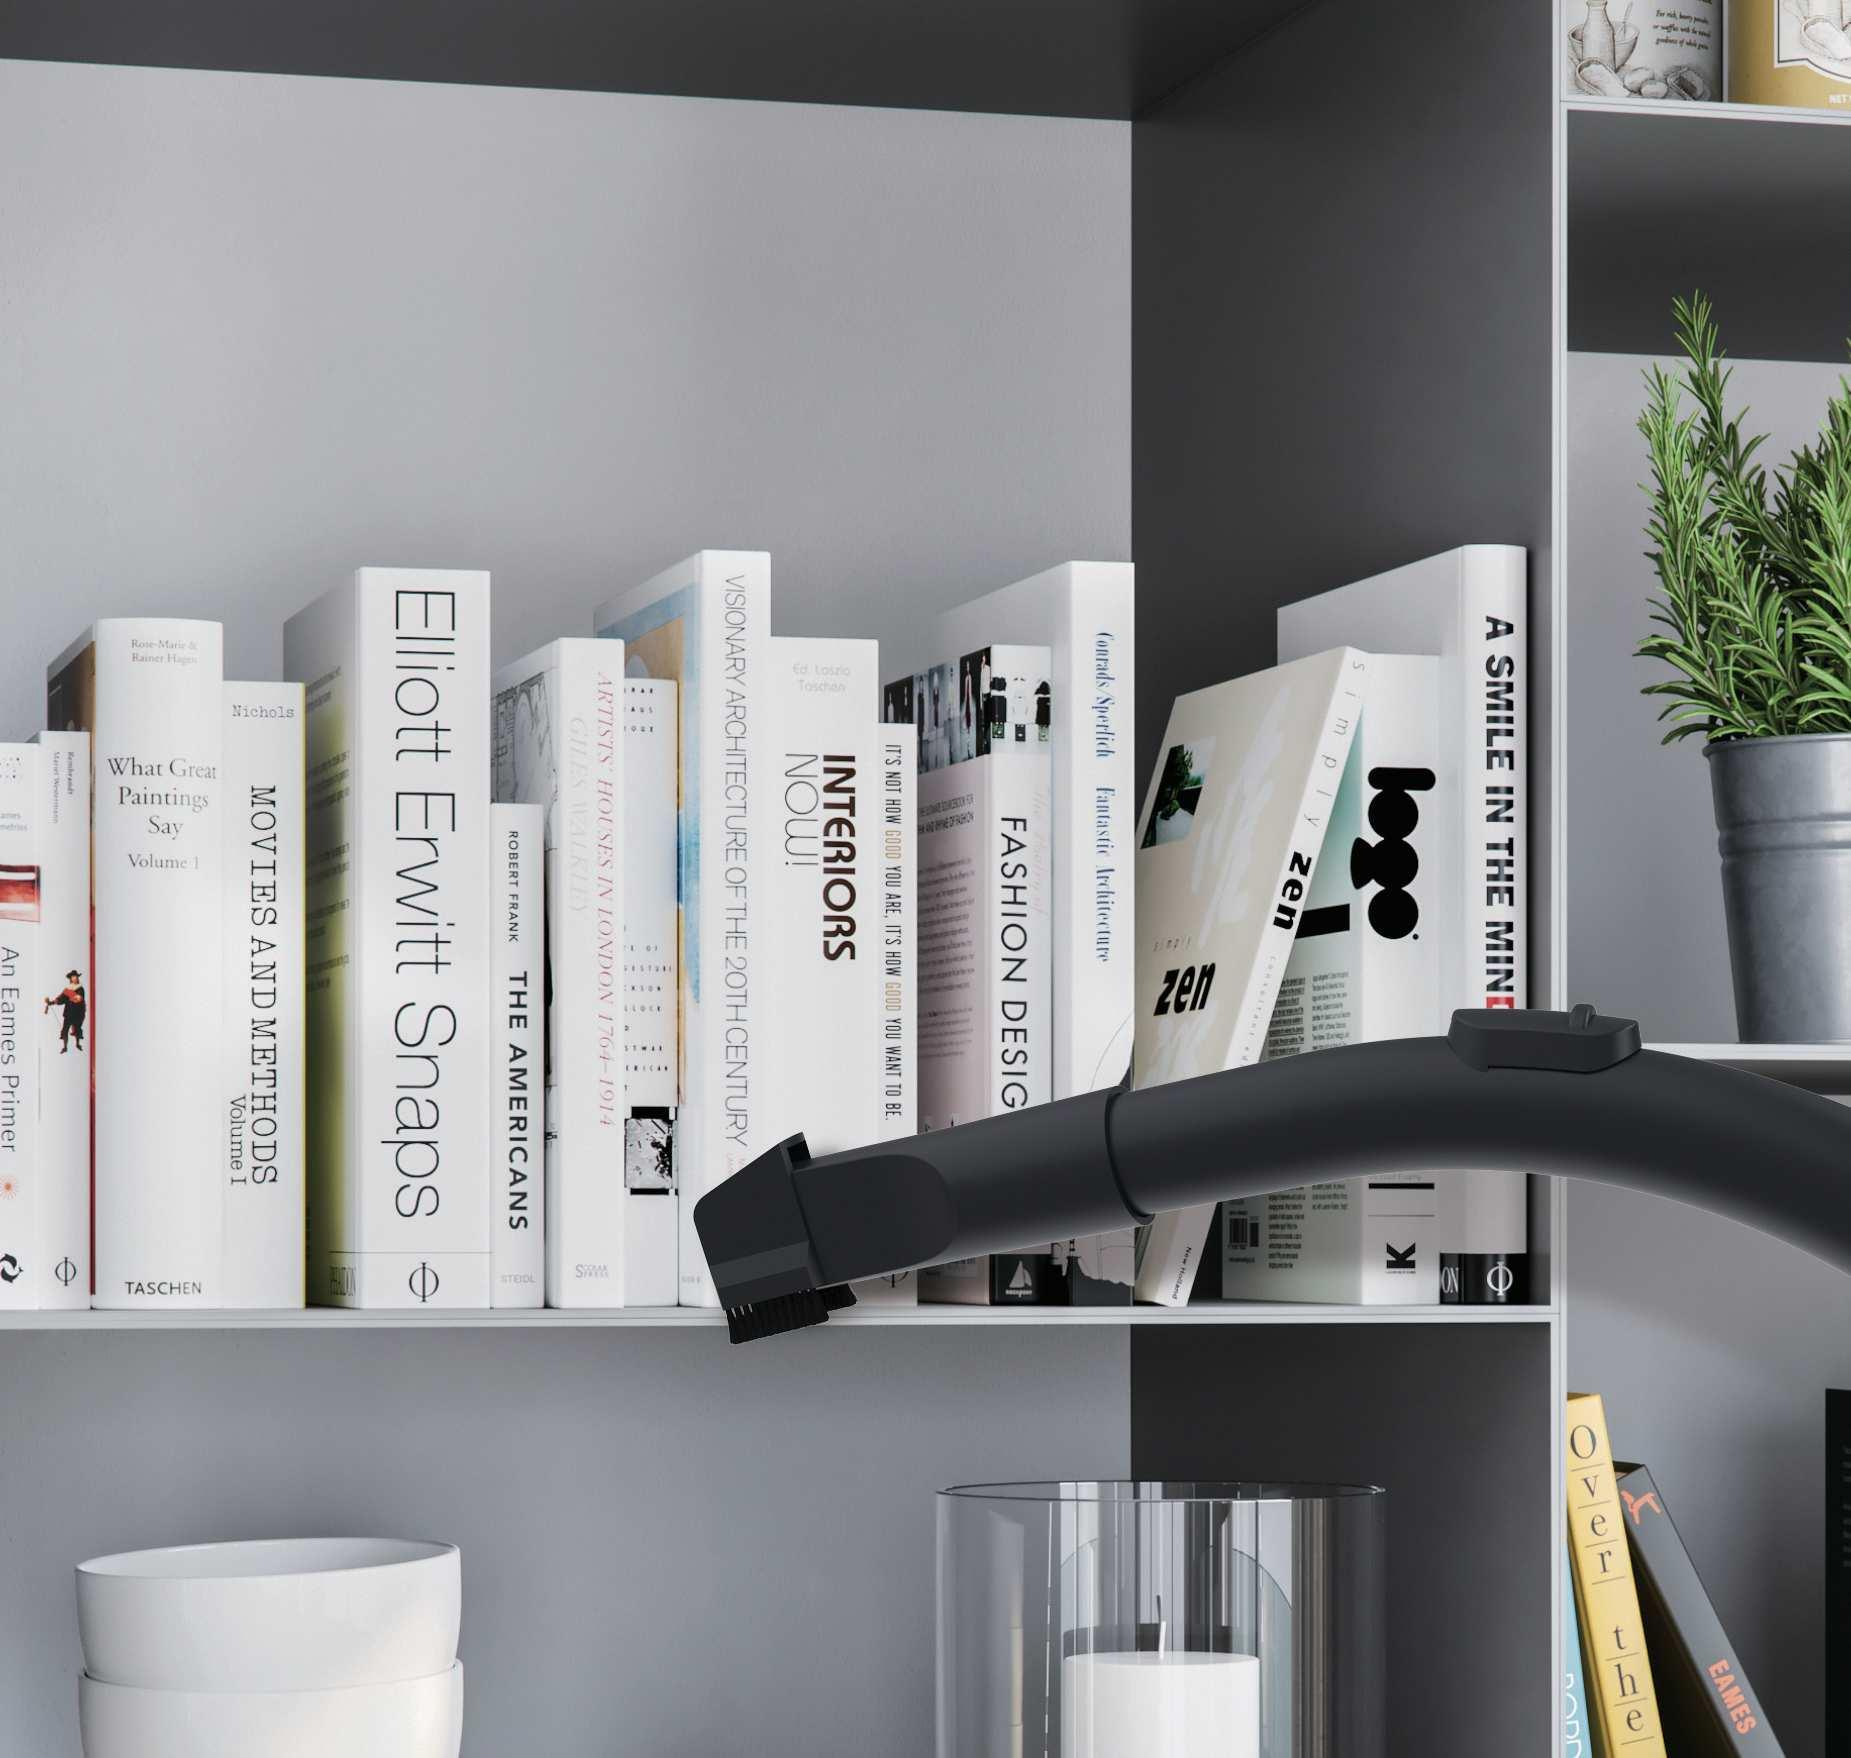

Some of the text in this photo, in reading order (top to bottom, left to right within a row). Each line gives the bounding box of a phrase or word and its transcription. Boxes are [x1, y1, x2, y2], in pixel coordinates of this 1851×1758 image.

[131, 638, 187, 651] Rose-Marie
[724, 575, 746, 686] VISIONARY
[1485, 615, 1514, 641] A
[131, 652, 198, 666] Rainer Hagen
[231, 704, 295, 719] Nichols
[1485, 654, 1515, 771] SMILE
[107, 757, 217, 779] What Great
[724, 688, 748, 862] ARCHITECTURE
[885, 743, 902, 766] IT'S
[118, 785, 209, 812] Paintings
[885, 771, 902, 794] NOT
[784, 753, 819, 866] NOW!
[885, 798, 902, 825] HOW
[1095, 787, 1116, 857] Fantastic
[1485, 786, 1515, 824] IN
[147, 814, 184, 840] Say
[885, 830, 901, 860] GOOD
[127, 853, 188, 870] Volume
[823, 755, 856, 961] INTERIORS
[885, 865, 902, 888] YOU
[1485, 837, 1515, 907] THE
[381, 590, 457, 1218] Elliott Erwitt Snaps
[508, 830, 519, 942] ROBERT FRANK
[724, 867, 748, 899] OF
[1273, 851, 1312, 931] zen
[725, 902, 748, 950] THE
[884, 892, 902, 919] ARE,
[1095, 865, 1116, 962] Architecture
[598, 906, 615, 1001] LONDON
[885, 925, 902, 946] IT'S
[250, 785, 279, 1185] MOVIES AND METHODS
[885, 951, 902, 977] HOW
[1001, 817, 1028, 1112] FASHION DESIG
[725, 956, 748, 1021] 20TH
[885, 982, 901, 1012] GOOD
[1152, 961, 1216, 1017] zen
[1, 946, 20, 1152] An Eames Primer
[885, 1018, 902, 1040] YOU
[885, 1046, 902, 1077] WANT
[509, 970, 529, 1230] THE AMERICANS
[725, 1027, 748, 1147] CENTURY
[885, 1084, 902, 1097] TO
[230, 1095, 247, 1171] Volume
[125, 1281, 202, 1296] TASCHEN
[501, 1273, 536, 1284] STEIDL
[1569, 1424, 1613, 1575] Over
[1613, 1625, 1645, 1733] the
[1707, 1658, 1757, 1736] EAMES
